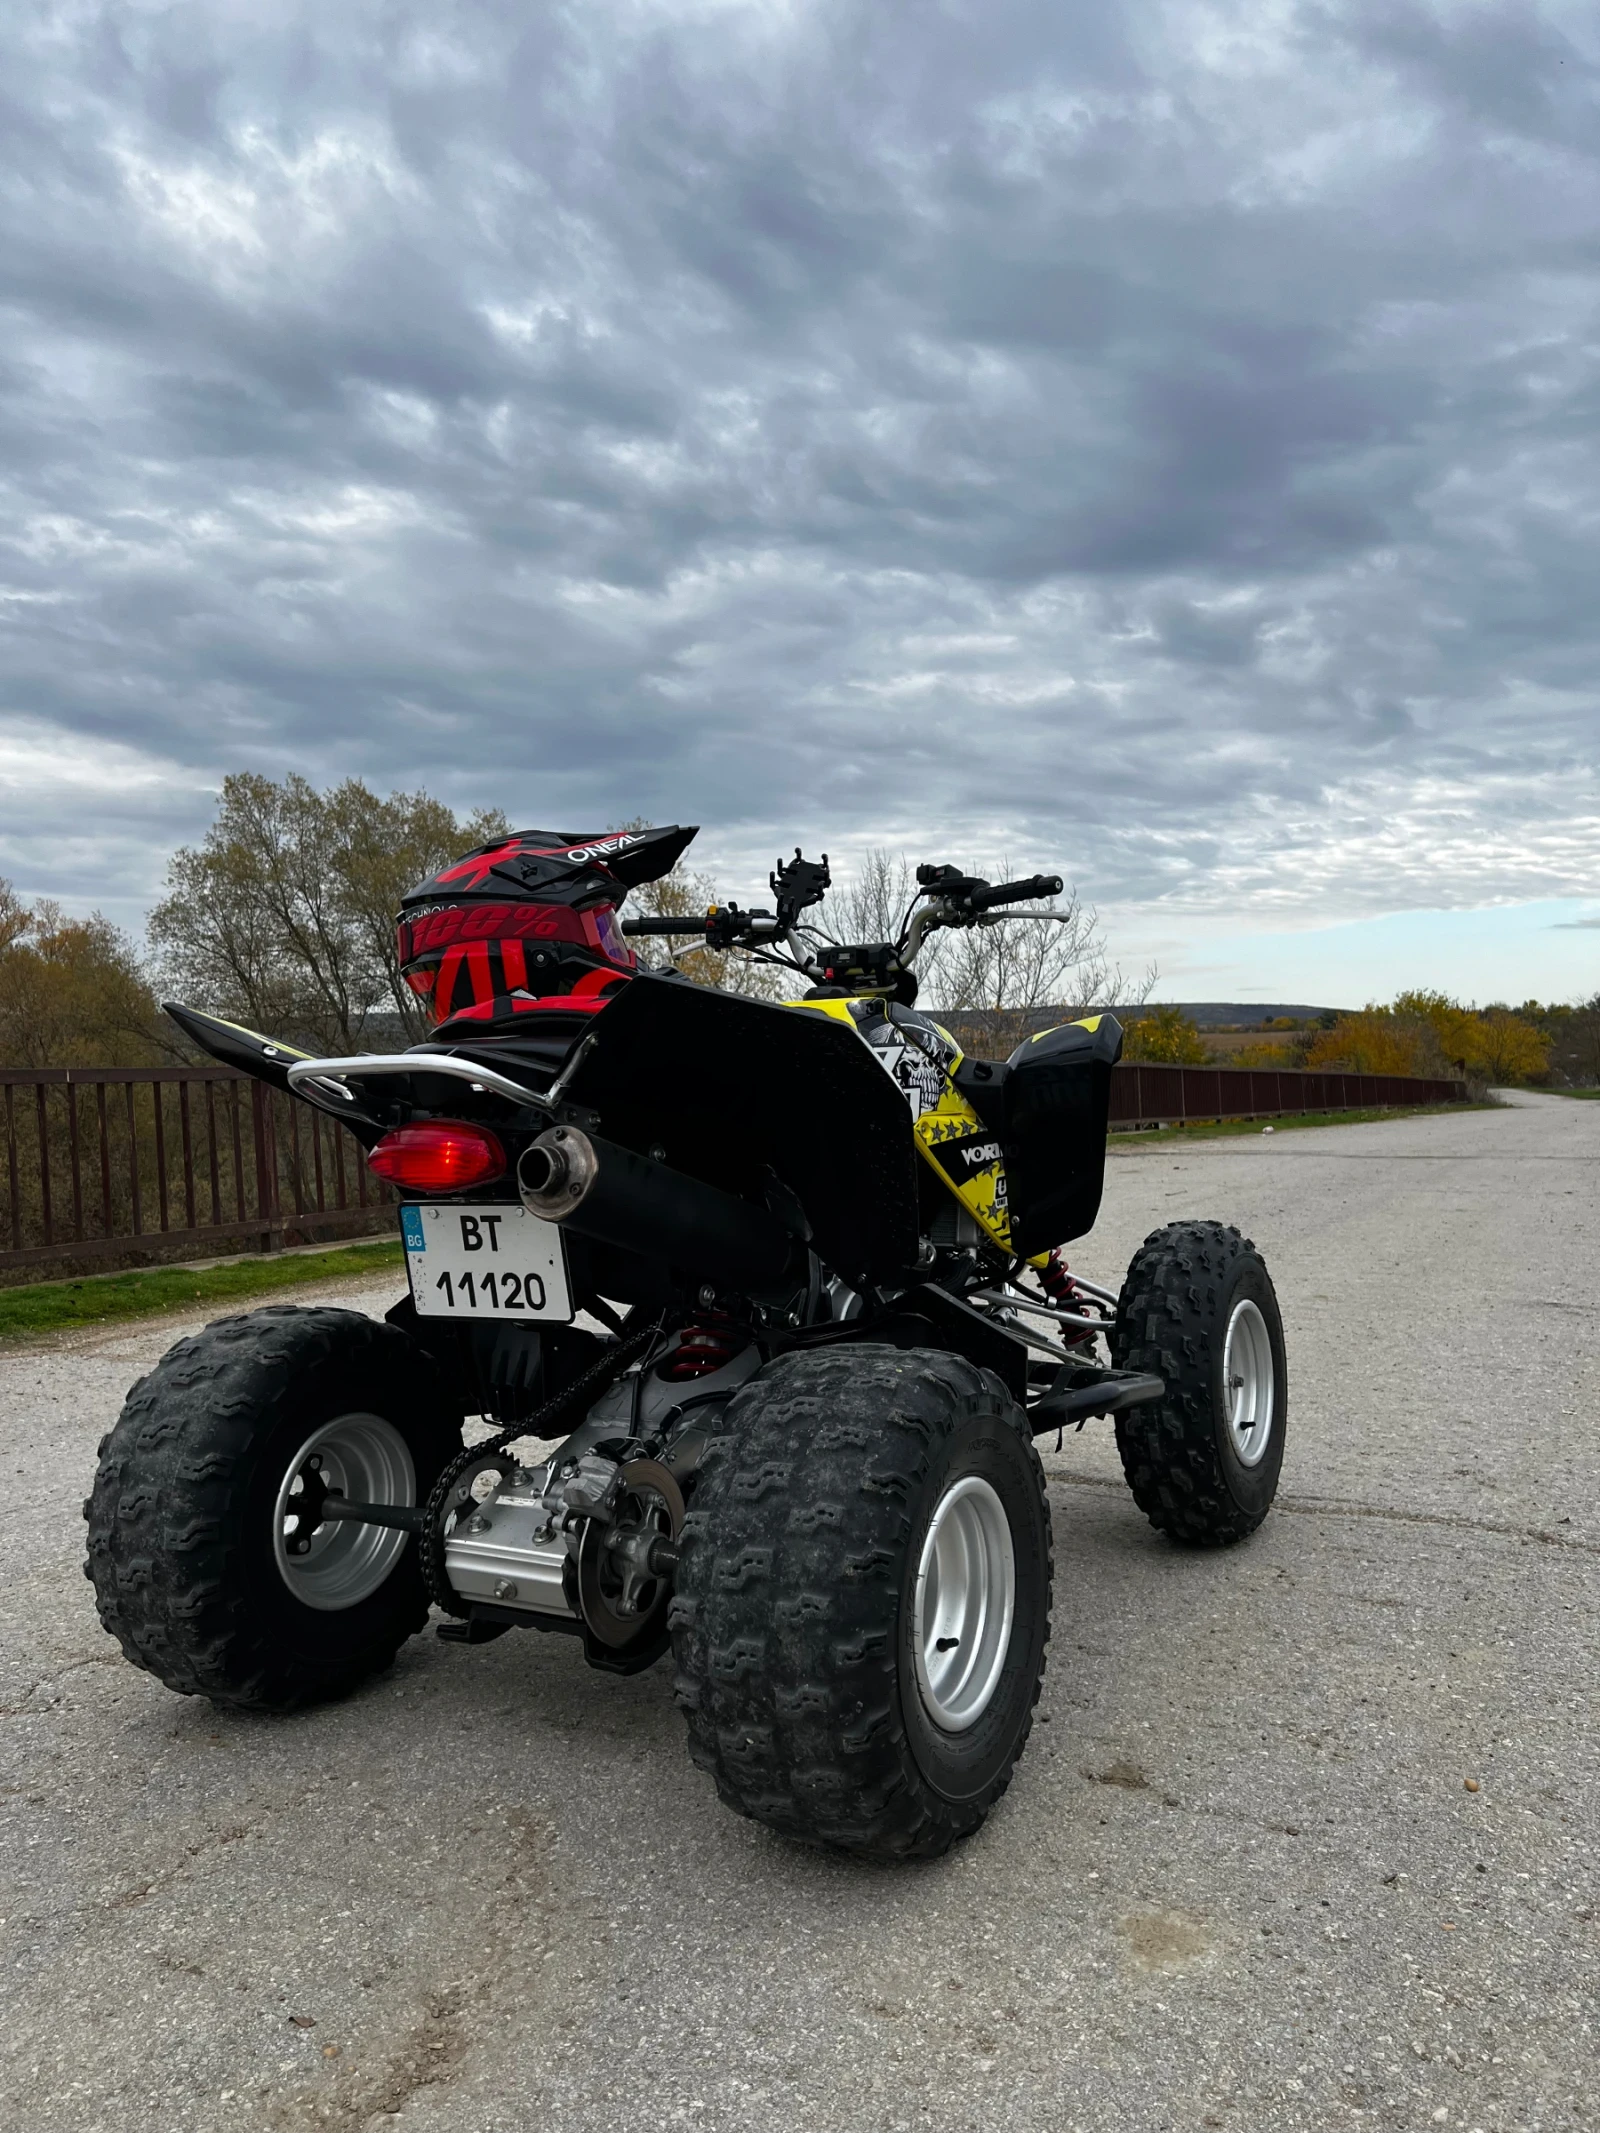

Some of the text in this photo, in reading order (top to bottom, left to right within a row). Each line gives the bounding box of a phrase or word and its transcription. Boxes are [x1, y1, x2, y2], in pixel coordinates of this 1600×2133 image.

[567, 834, 646, 862] ONEAL
[412, 905, 560, 953] 100%
[407, 1234, 422, 1247] BG
[460, 1215, 502, 1252] BT
[436, 1271, 546, 1311] 11120
